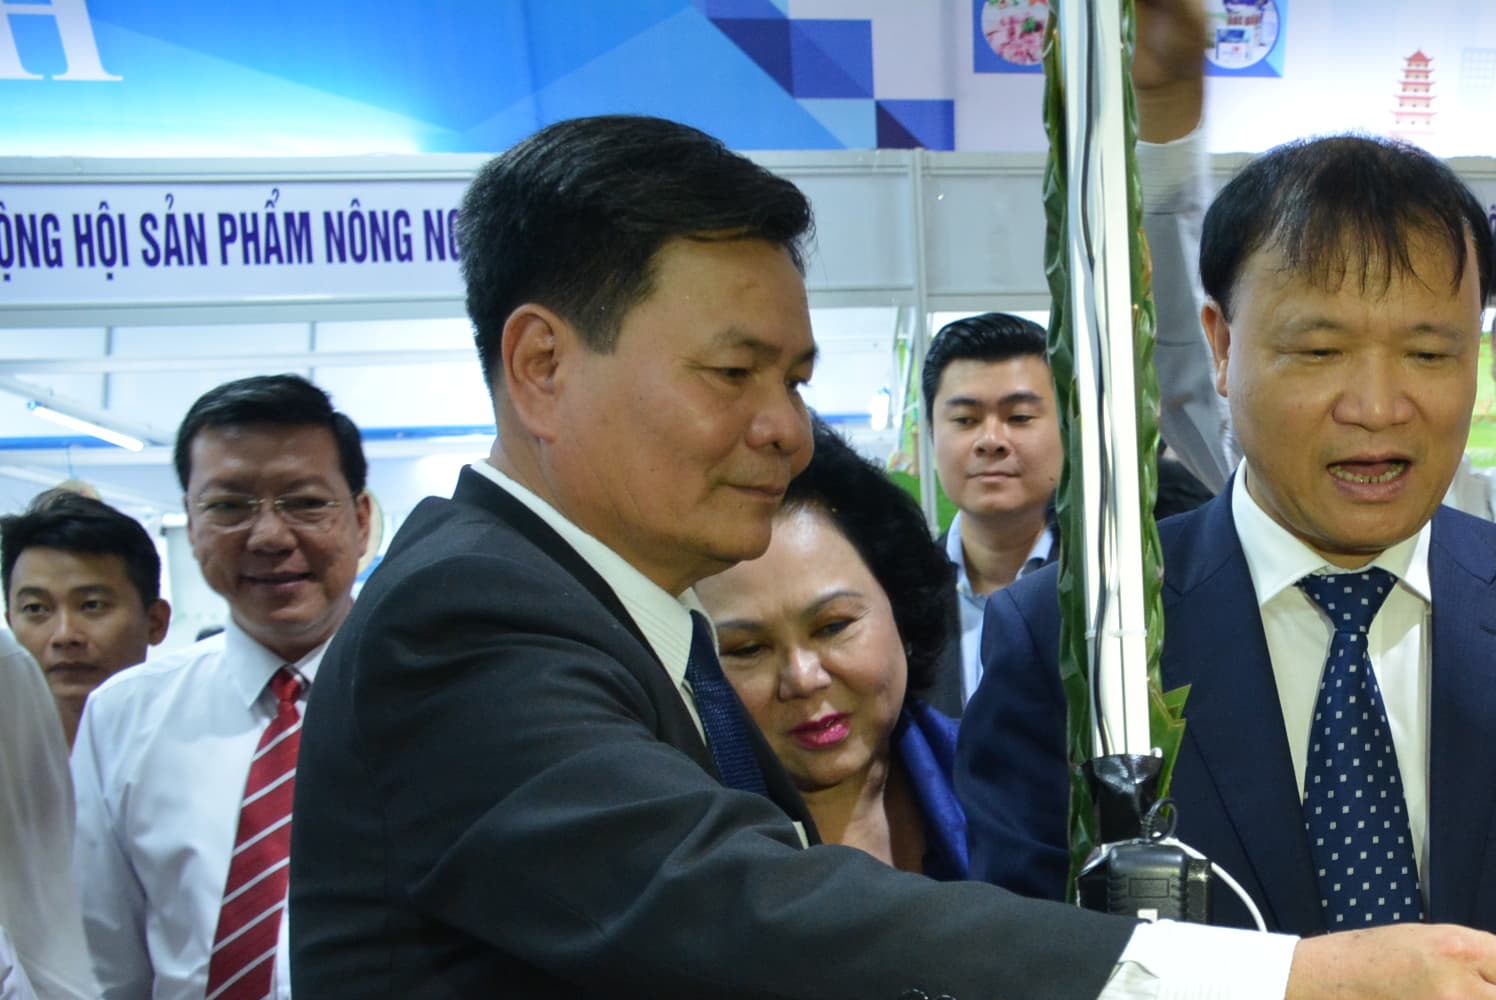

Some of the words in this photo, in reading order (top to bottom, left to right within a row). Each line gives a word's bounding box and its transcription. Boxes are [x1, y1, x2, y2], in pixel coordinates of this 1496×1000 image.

[72, 200, 129, 280] HỘI
[140, 192, 208, 267] SẢN
[218, 187, 313, 265] PHẨM
[323, 198, 414, 263] NÔNG
